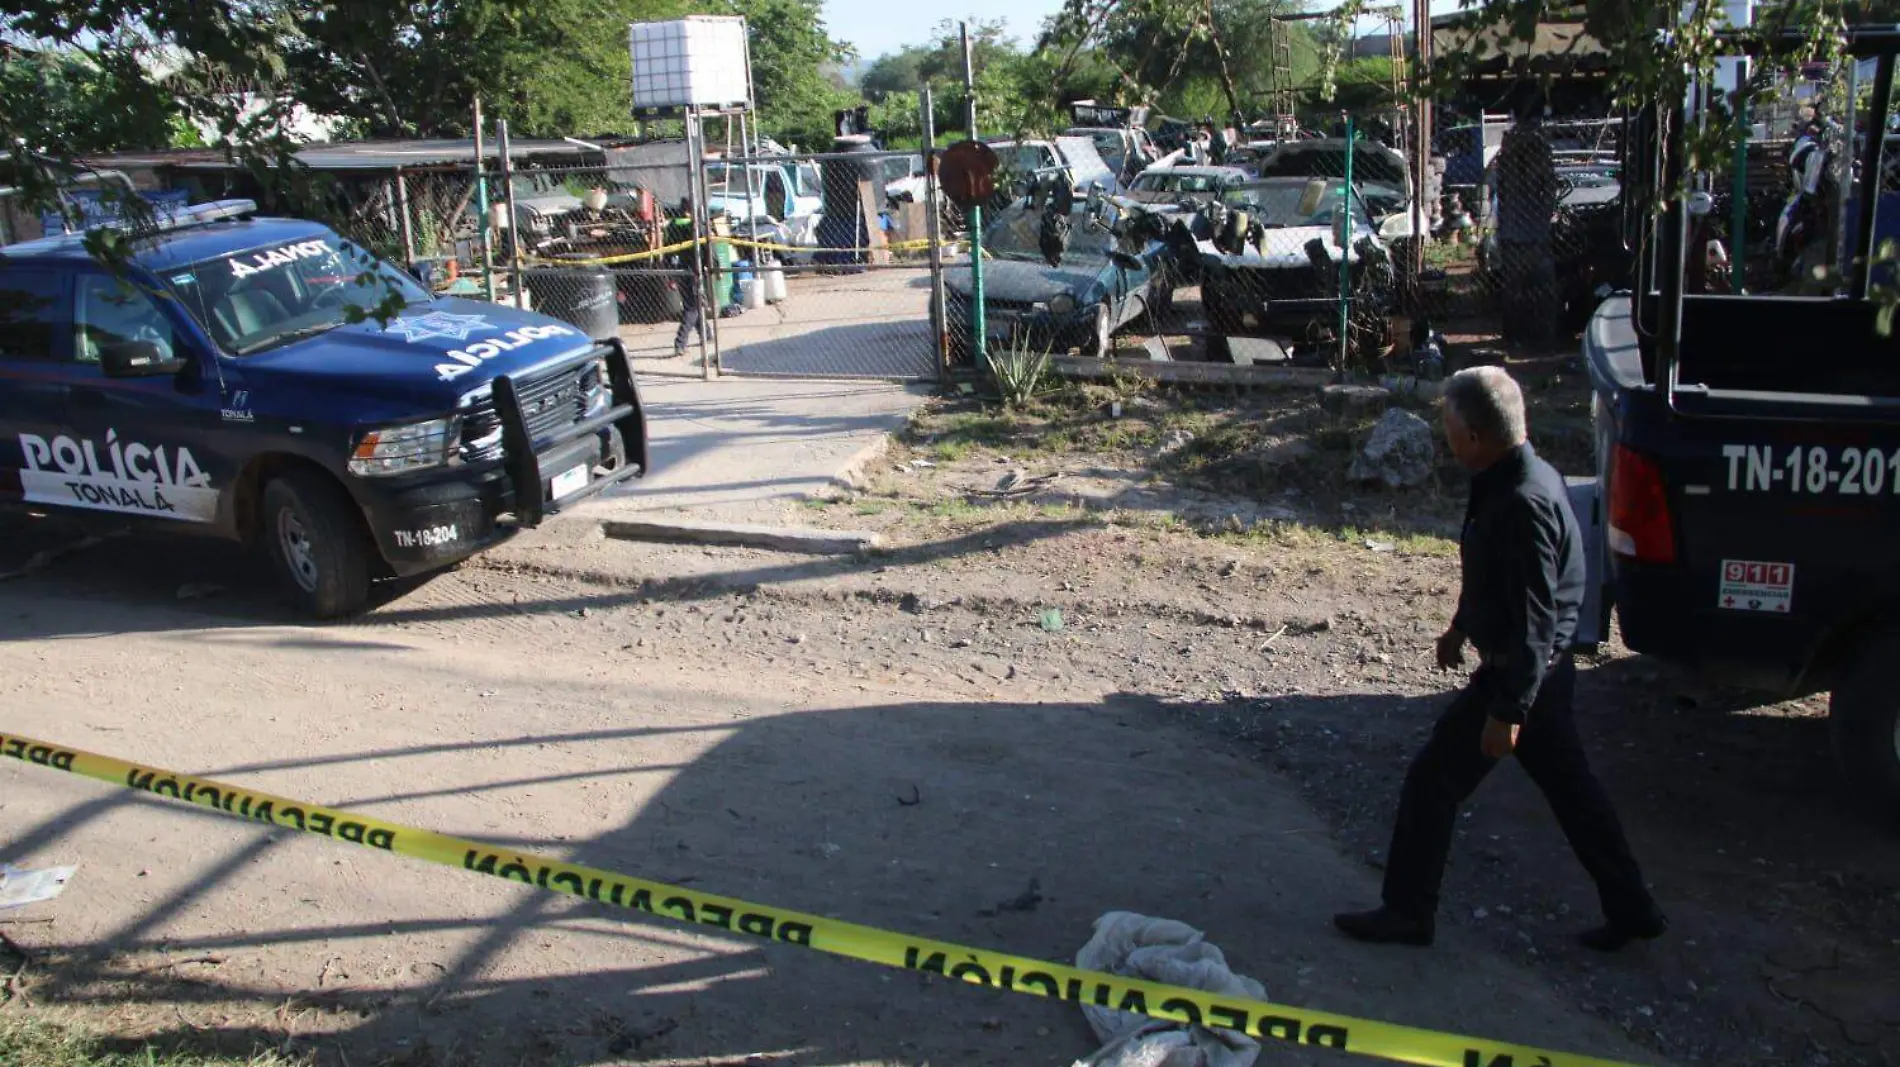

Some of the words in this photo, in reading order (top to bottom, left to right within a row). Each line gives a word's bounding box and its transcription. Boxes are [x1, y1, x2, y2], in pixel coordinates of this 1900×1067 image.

[18, 427, 211, 489] POLÍCIA
[1722, 444, 1900, 495] TN-18-201
[65, 481, 175, 512] TONALÁ
[394, 524, 457, 547] TN-18-204
[1726, 563, 1786, 583] 911
